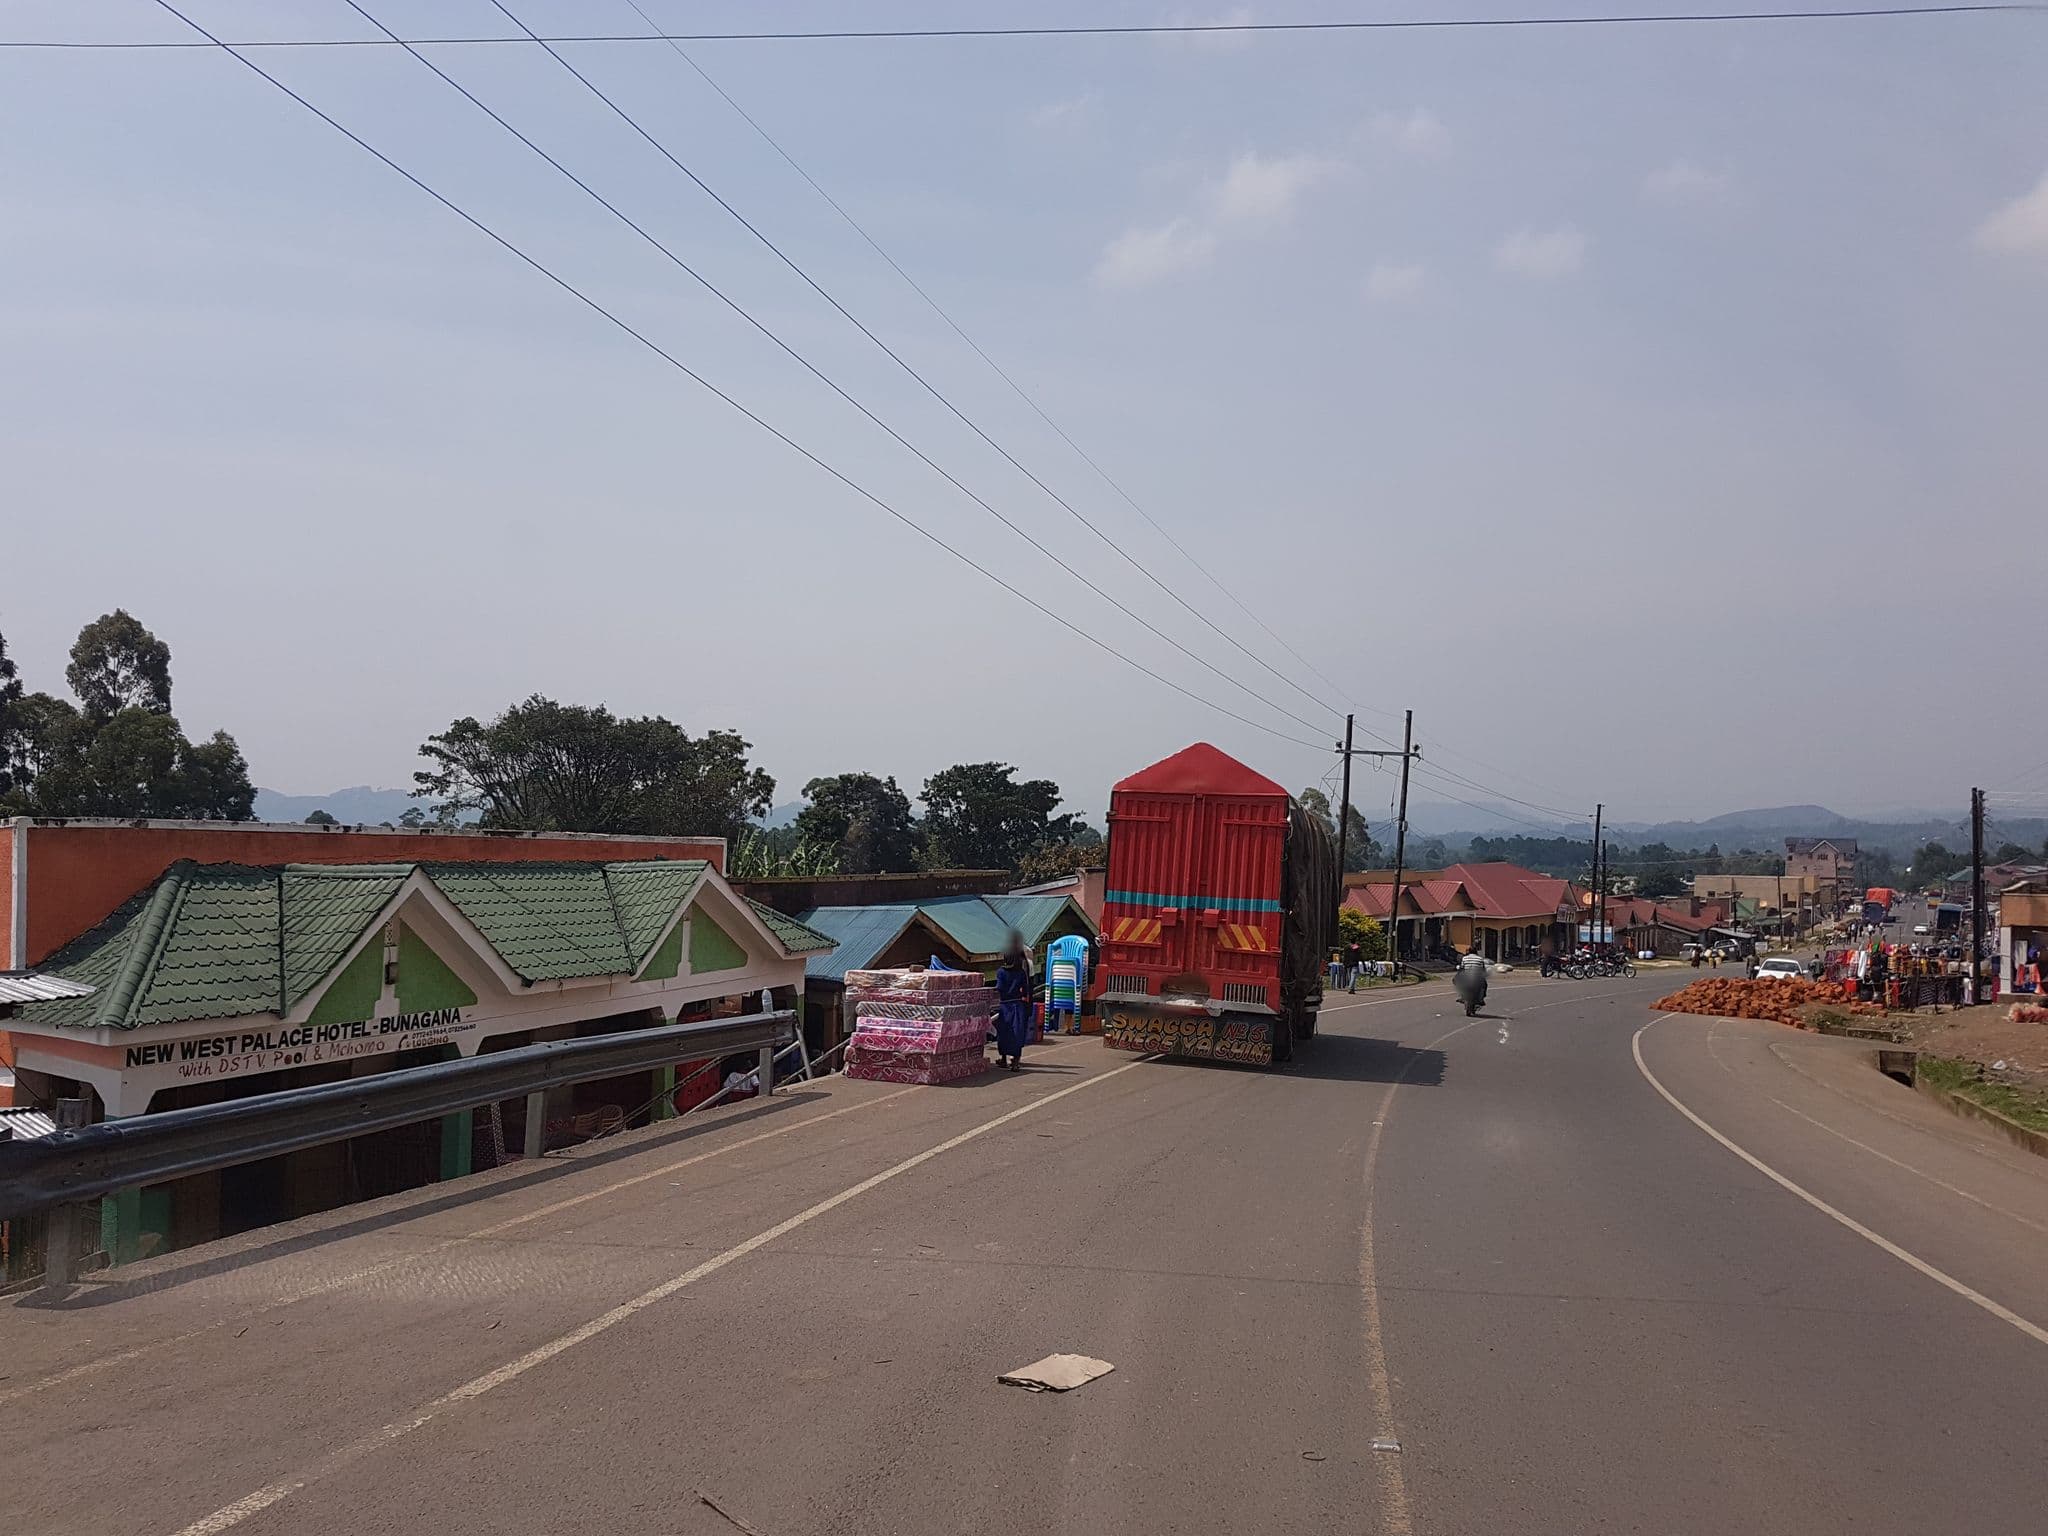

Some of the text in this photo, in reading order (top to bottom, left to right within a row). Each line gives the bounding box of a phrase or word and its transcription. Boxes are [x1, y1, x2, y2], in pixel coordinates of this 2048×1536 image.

[1111, 1012, 1215, 1037] SWAGGA
[126, 1043, 176, 1067] NEW
[180, 1036, 237, 1060] WEST
[241, 1028, 313, 1053] PALACE
[412, 1035, 449, 1047] LODGING
[1182, 1036, 1214, 1057] YA
[178, 1061, 213, 1077] With
[313, 1045, 323, 1060] &
